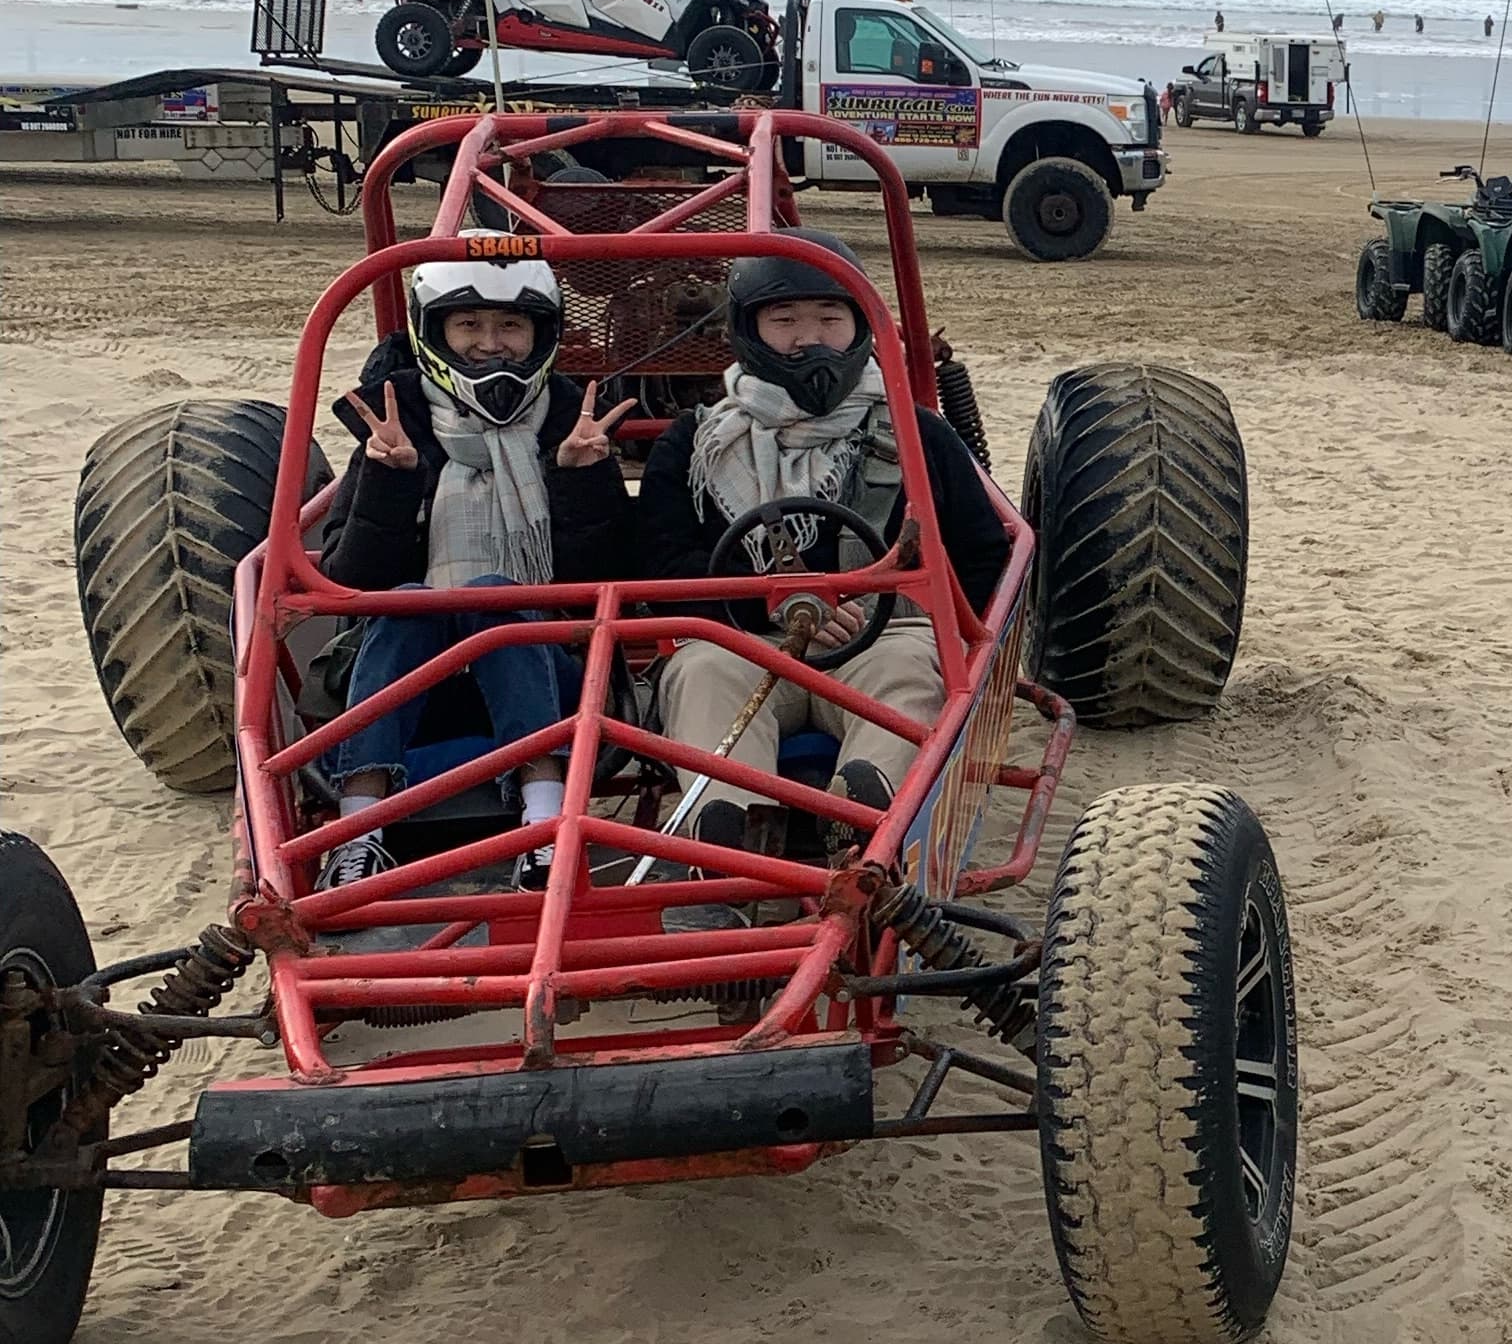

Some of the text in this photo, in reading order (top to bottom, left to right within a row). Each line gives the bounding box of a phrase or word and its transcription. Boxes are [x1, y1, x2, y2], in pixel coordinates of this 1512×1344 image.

[982, 90, 1105, 105] WHERE THE FUN NEVER SETS!
[827, 110, 976, 123] ADVENTURE STARTS NOW!
[116, 128, 182, 139] NOT FOR HIRE
[468, 237, 538, 257] SB403
